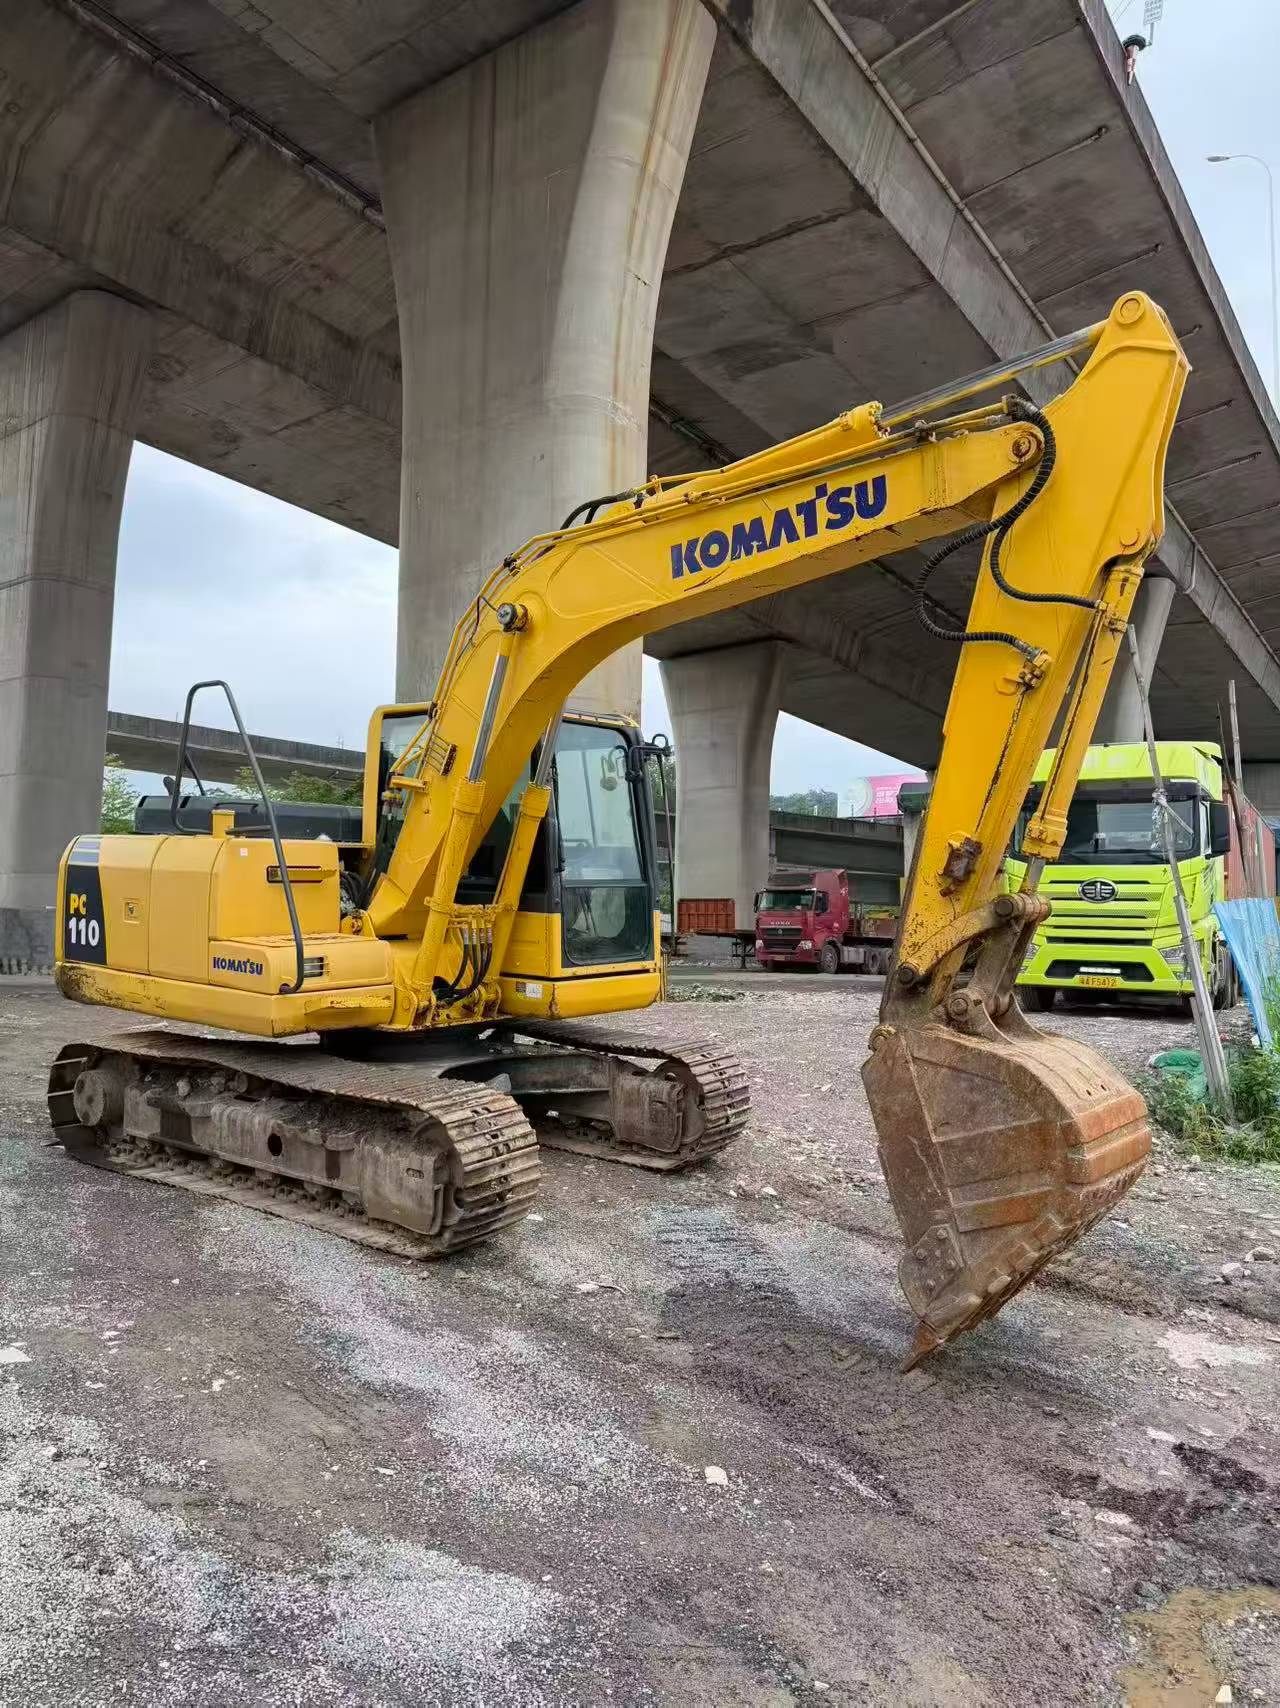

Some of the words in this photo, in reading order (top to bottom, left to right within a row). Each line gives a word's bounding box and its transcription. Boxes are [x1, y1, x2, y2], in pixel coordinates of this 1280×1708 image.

[671, 474, 887, 579] KOMATSU
[69, 893, 87, 915] PC
[69, 916, 99, 946] 110
[212, 956, 264, 976] KOMATSU
